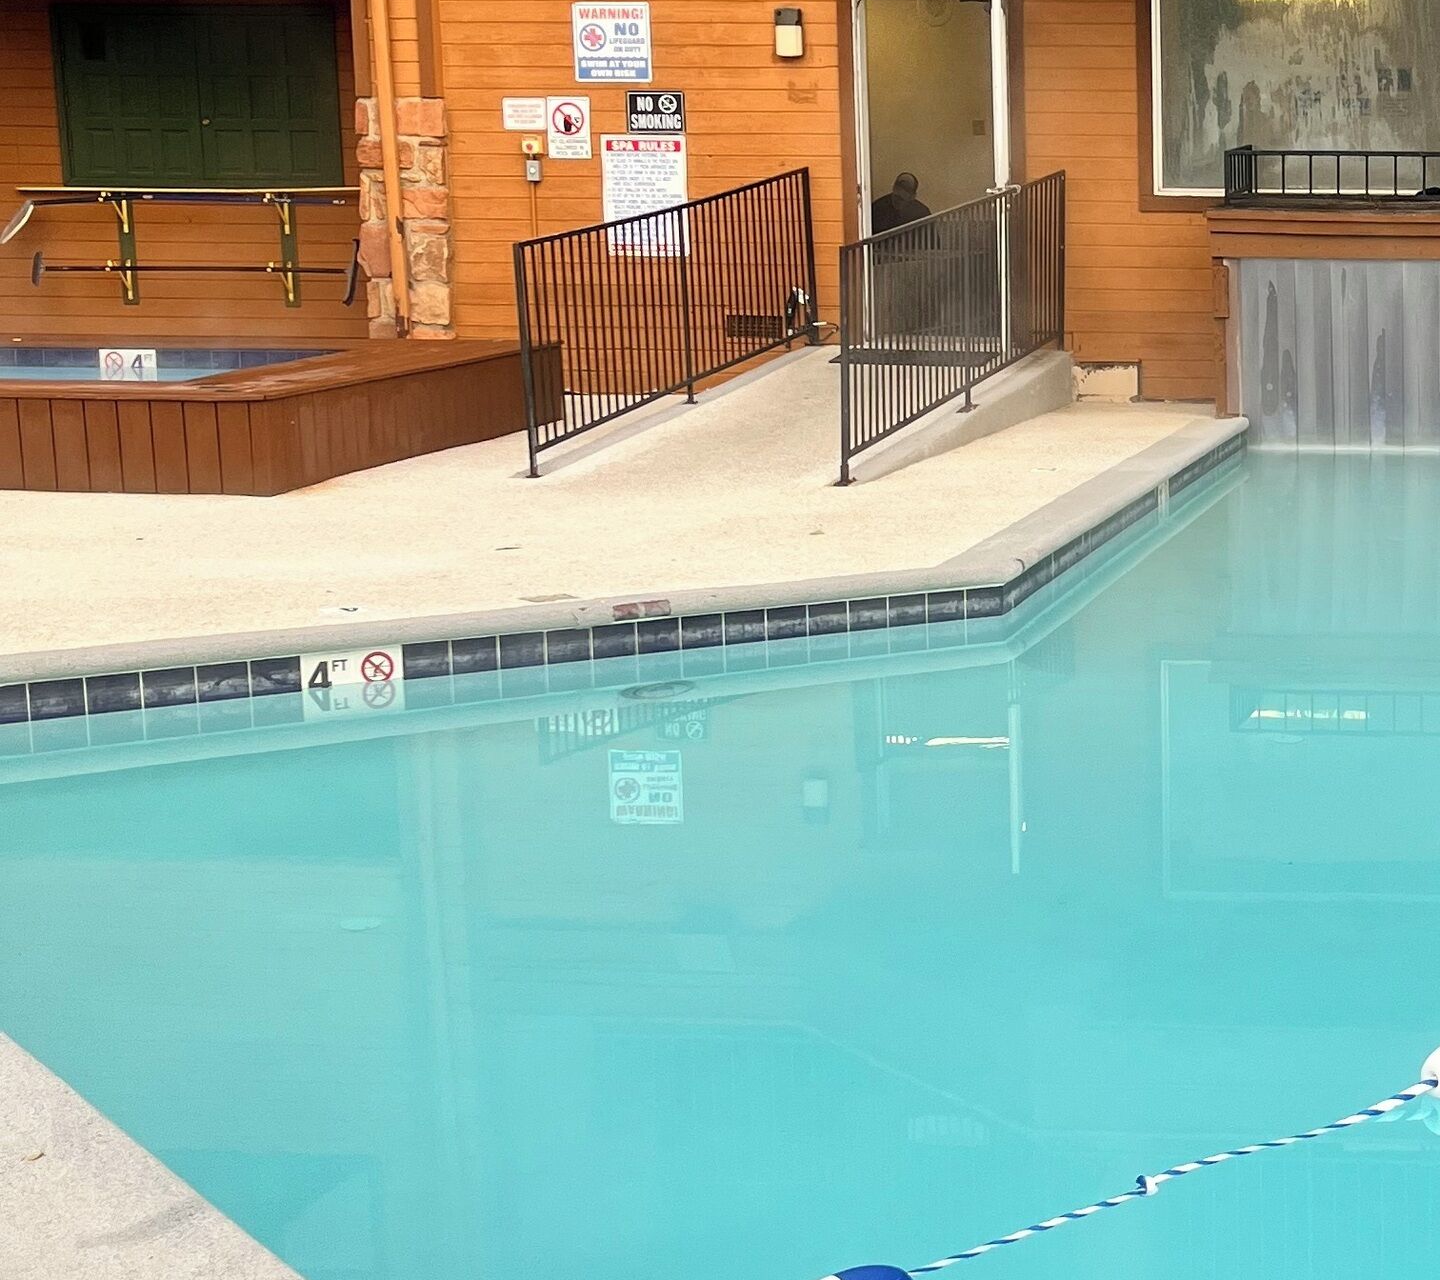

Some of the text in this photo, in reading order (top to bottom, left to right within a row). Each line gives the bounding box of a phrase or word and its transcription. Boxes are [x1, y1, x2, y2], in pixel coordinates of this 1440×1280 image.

[579, 8, 643, 19] WARNING!
[614, 23, 639, 36] NO
[609, 60, 620, 68] AT
[636, 96, 654, 112] NO
[631, 114, 682, 129] SMOKING
[611, 141, 675, 151] SPA RULES
[131, 354, 143, 368] 4
[308, 659, 348, 688] 4 FT
